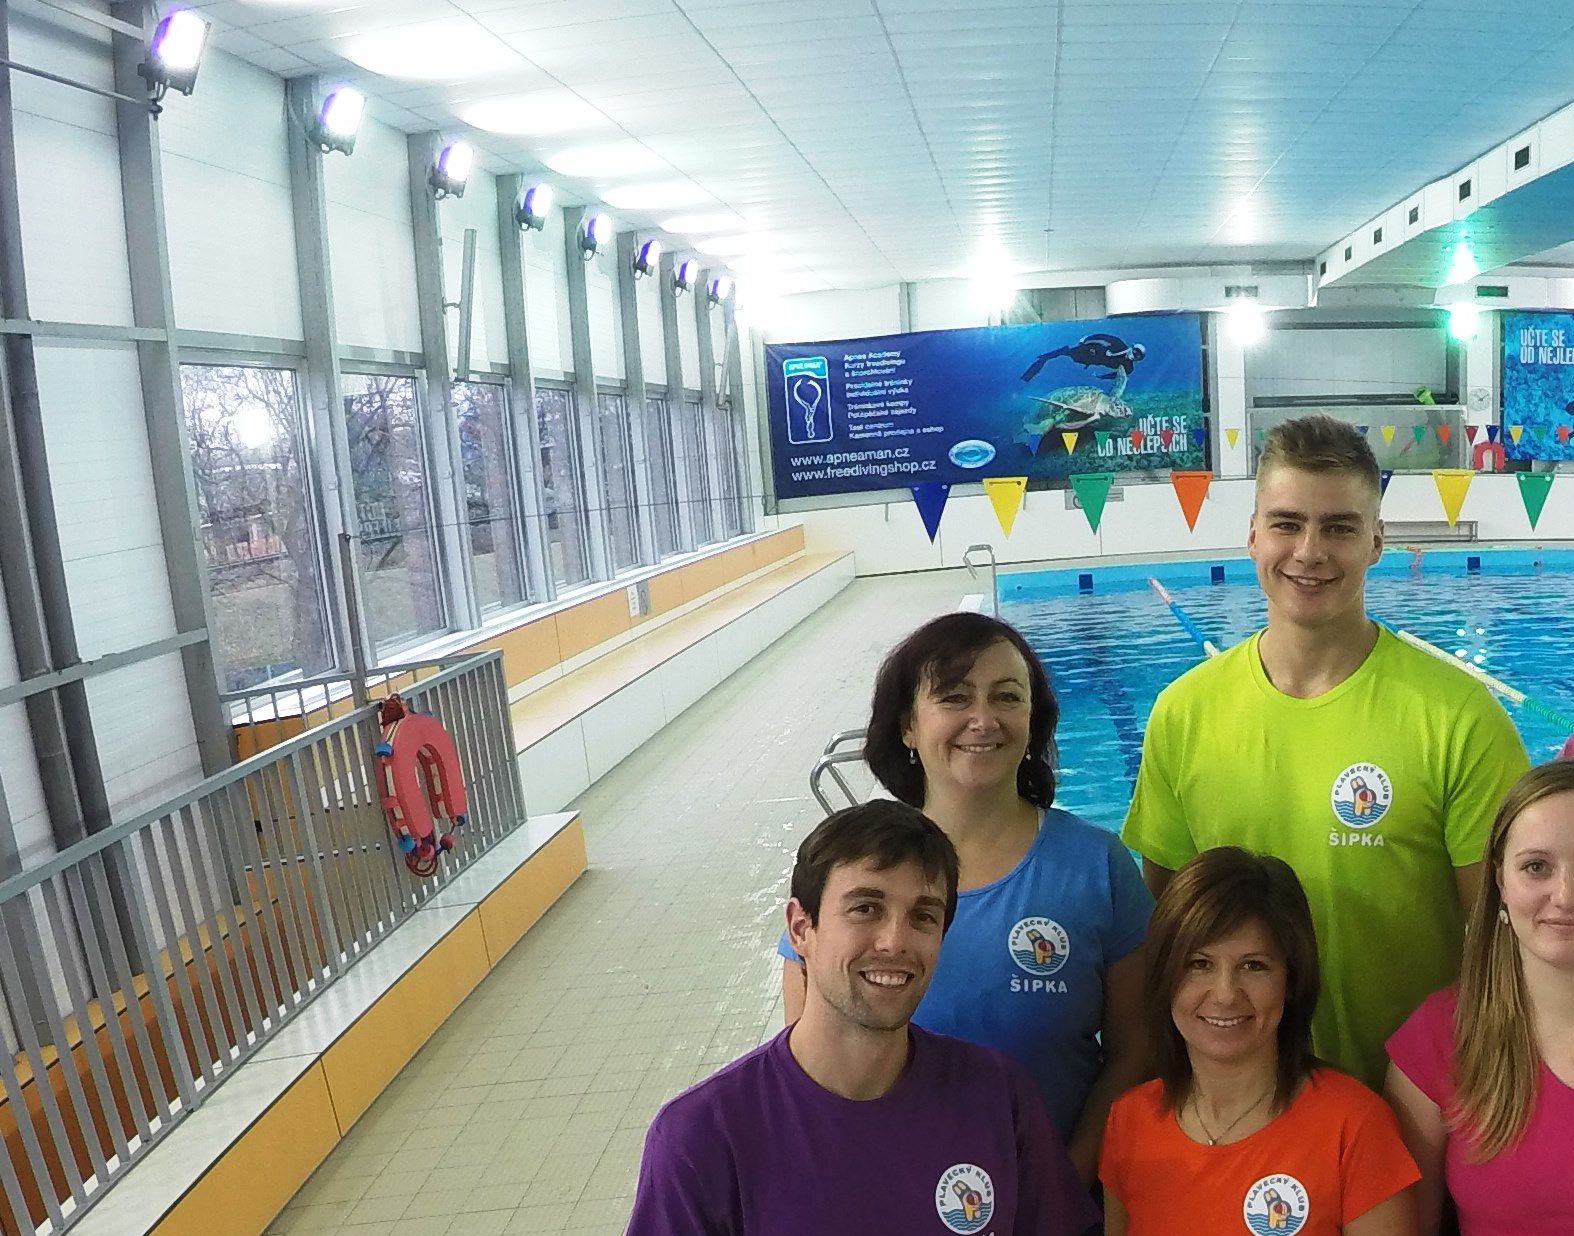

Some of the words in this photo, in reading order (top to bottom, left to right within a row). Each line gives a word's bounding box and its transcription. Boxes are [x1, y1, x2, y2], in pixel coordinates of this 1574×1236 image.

[1520, 325, 1549, 346] UČTE
[1552, 329, 1565, 347] SE
[1520, 346, 1535, 364] OD
[1139, 414, 1169, 435] UČTE
[1172, 415, 1187, 434] SE
[790, 447, 911, 467] www.apneaman.cz
[791, 460, 937, 482] www.freedivingshop.cz
[1328, 827, 1384, 847] ŠIPKA
[1009, 973, 1068, 993] ŠIPKA
